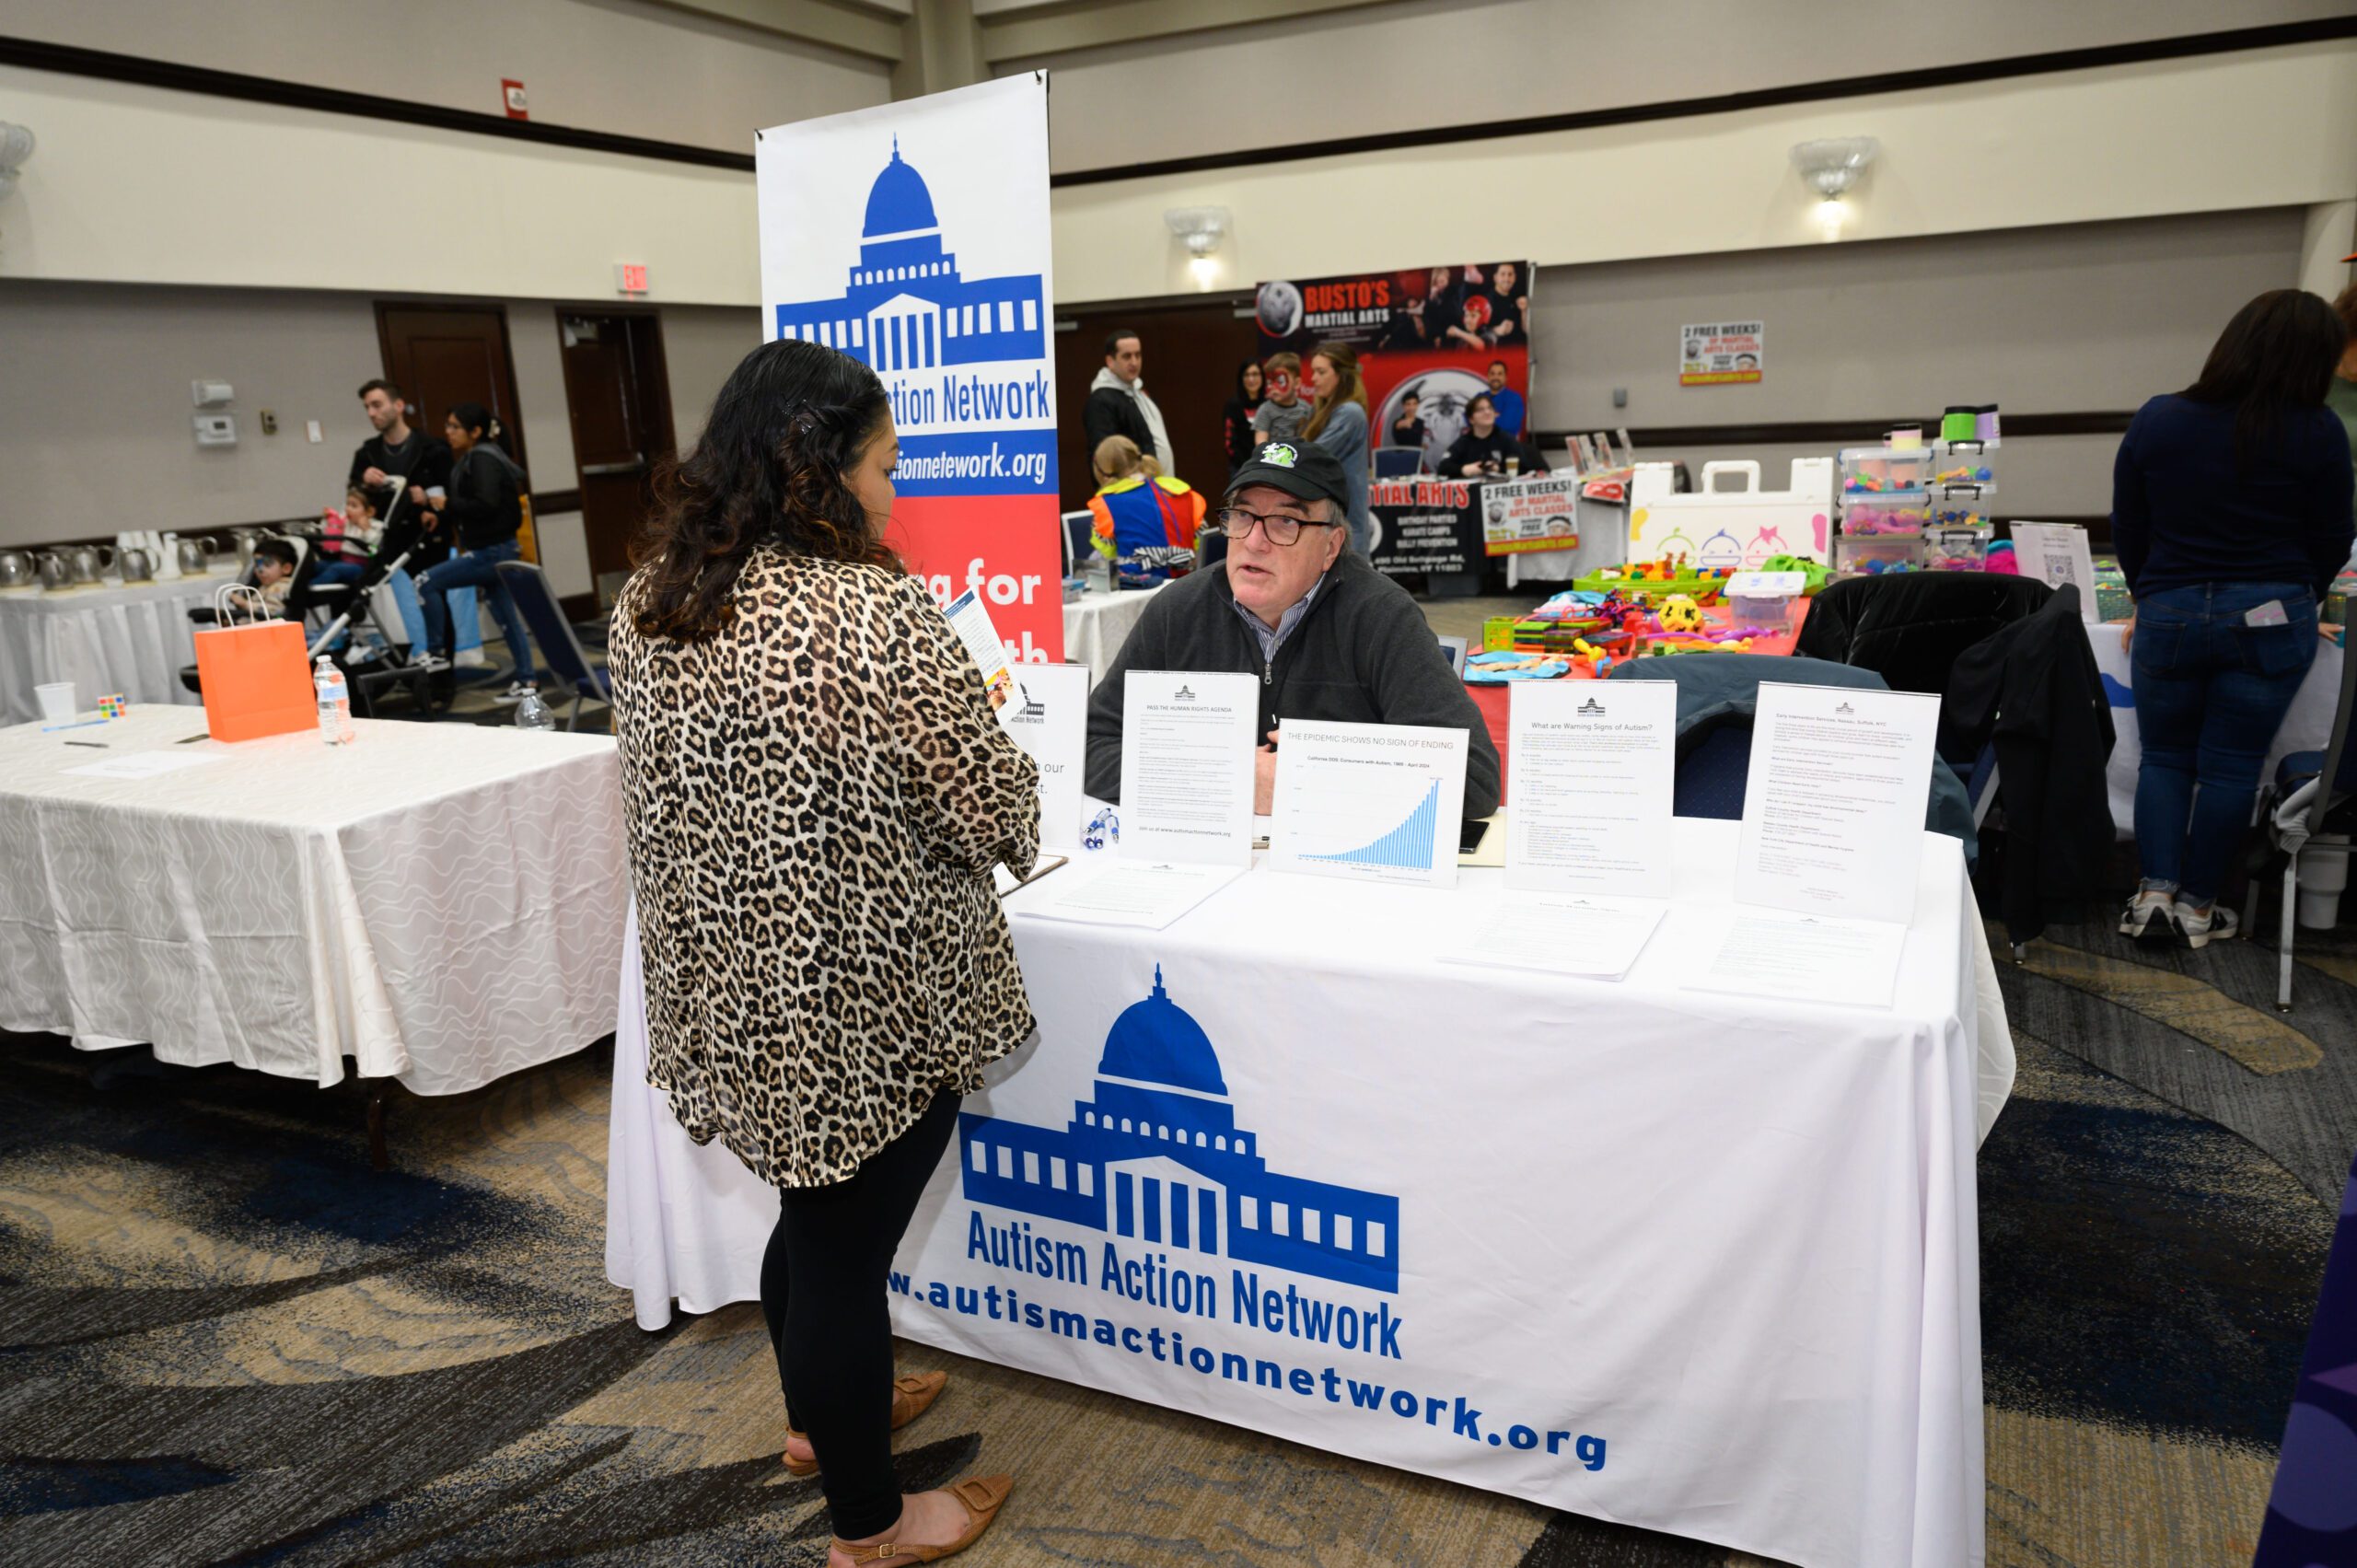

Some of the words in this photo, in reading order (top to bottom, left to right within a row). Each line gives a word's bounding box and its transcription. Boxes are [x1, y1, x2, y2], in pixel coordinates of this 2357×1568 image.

[1304, 279, 1390, 312] BUSTO'S
[1305, 311, 1355, 329] MARTIAL
[1358, 308, 1390, 324] ARTS
[1693, 325, 1718, 336] FREE
[944, 369, 1050, 423] Network
[1416, 482, 1470, 508] ARTS
[1484, 488, 1492, 500] 2
[1494, 485, 1524, 498] FREE
[1526, 480, 1572, 495] WEEKS!
[1527, 494, 1566, 505] MARTIAL
[1509, 507, 1531, 517] ARTS
[1533, 503, 1573, 516] CLASSES
[966, 558, 1041, 606] for
[1563, 723, 1592, 731] Warning
[1594, 723, 1613, 731] Signs
[1288, 732, 1303, 740] THE
[1304, 733, 1341, 743] EPIDEMIC
[1341, 736, 1371, 745] SHOWS
[1373, 738, 1386, 746] NO
[1387, 738, 1407, 747] SIGN
[1409, 739, 1420, 748] OF
[1421, 740, 1454, 749] ENDING
[1044, 763, 1065, 773] our
[966, 1210, 1087, 1287] Autism
[1101, 1243, 1216, 1319] Action
[1233, 1268, 1402, 1361] Network
